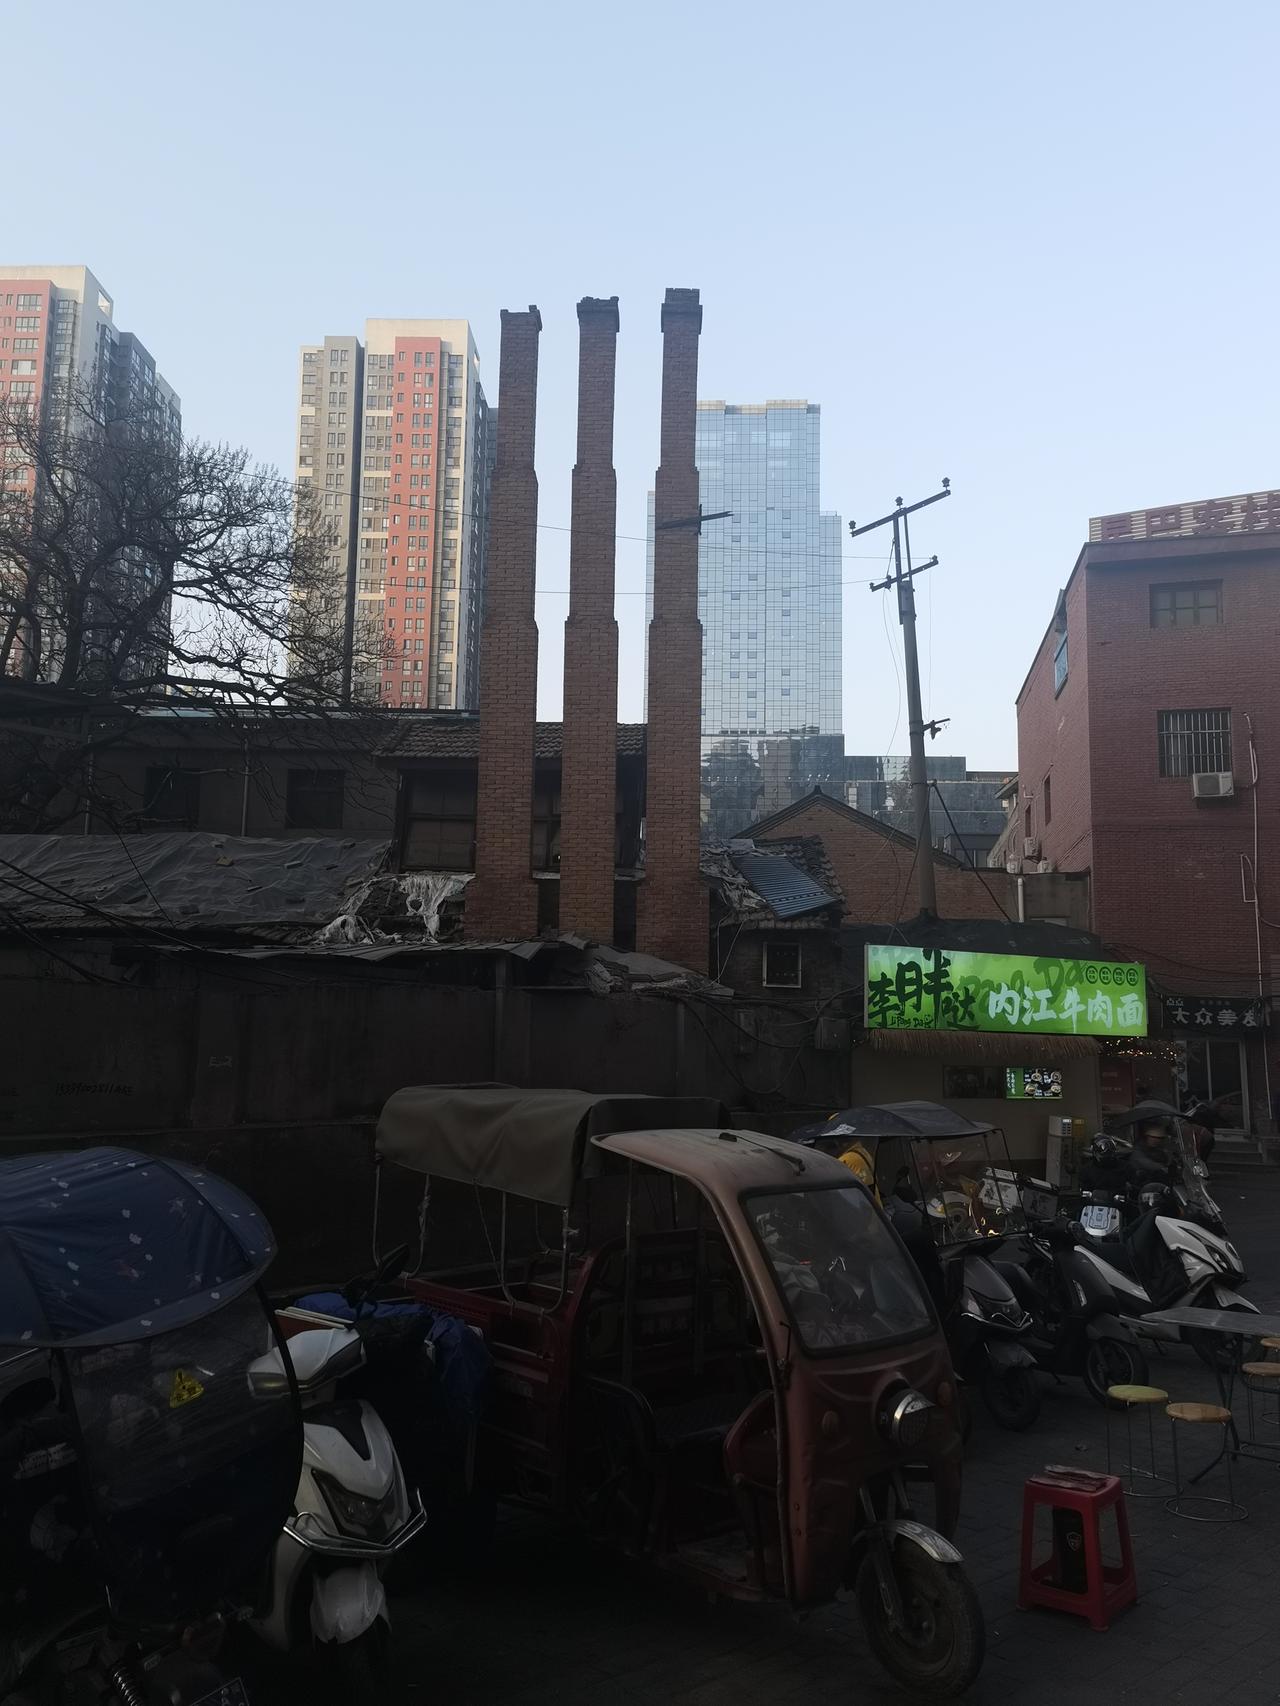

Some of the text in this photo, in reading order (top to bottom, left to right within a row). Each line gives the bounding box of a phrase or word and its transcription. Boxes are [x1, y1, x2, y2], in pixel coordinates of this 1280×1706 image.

[988, 982, 1143, 1033] 内江牛肉面
